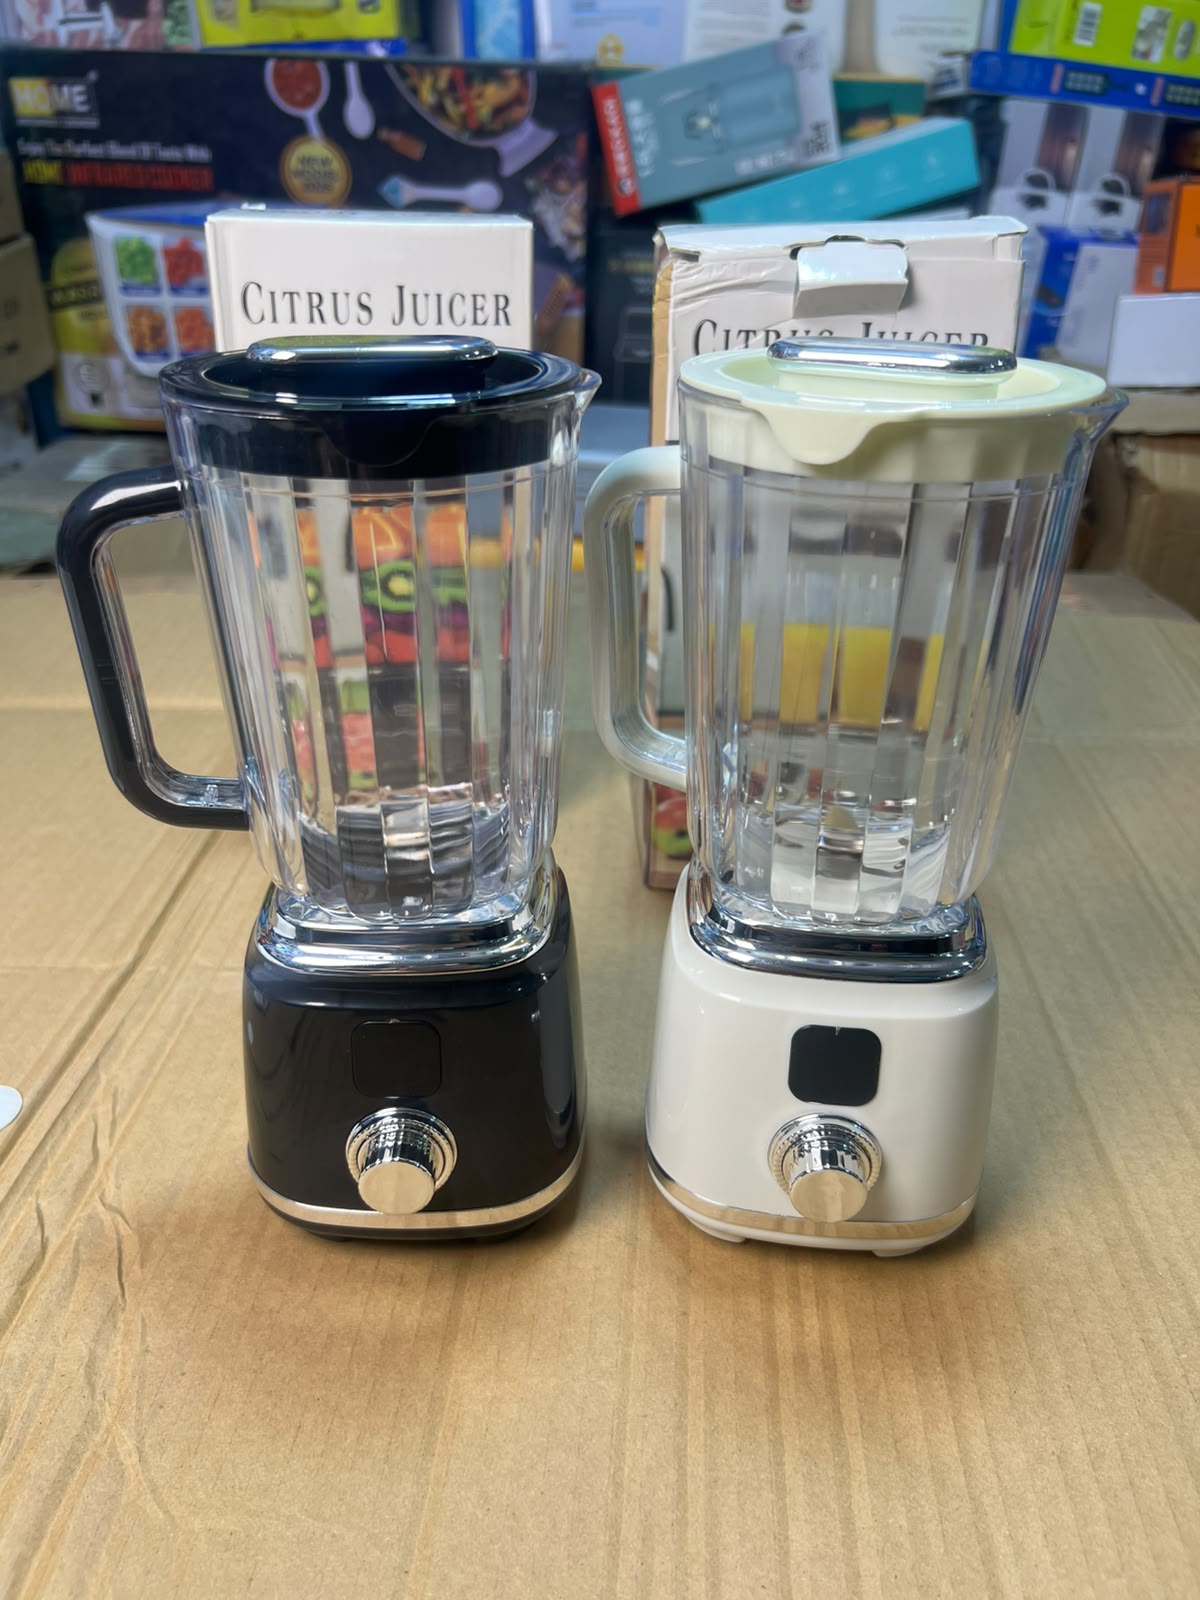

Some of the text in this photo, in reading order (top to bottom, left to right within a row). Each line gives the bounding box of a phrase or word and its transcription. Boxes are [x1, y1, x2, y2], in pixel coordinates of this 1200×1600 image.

[13, 82, 90, 114] HOME
[241, 281, 511, 327] CITRUS JUICER
[694, 319, 834, 356] CITR
